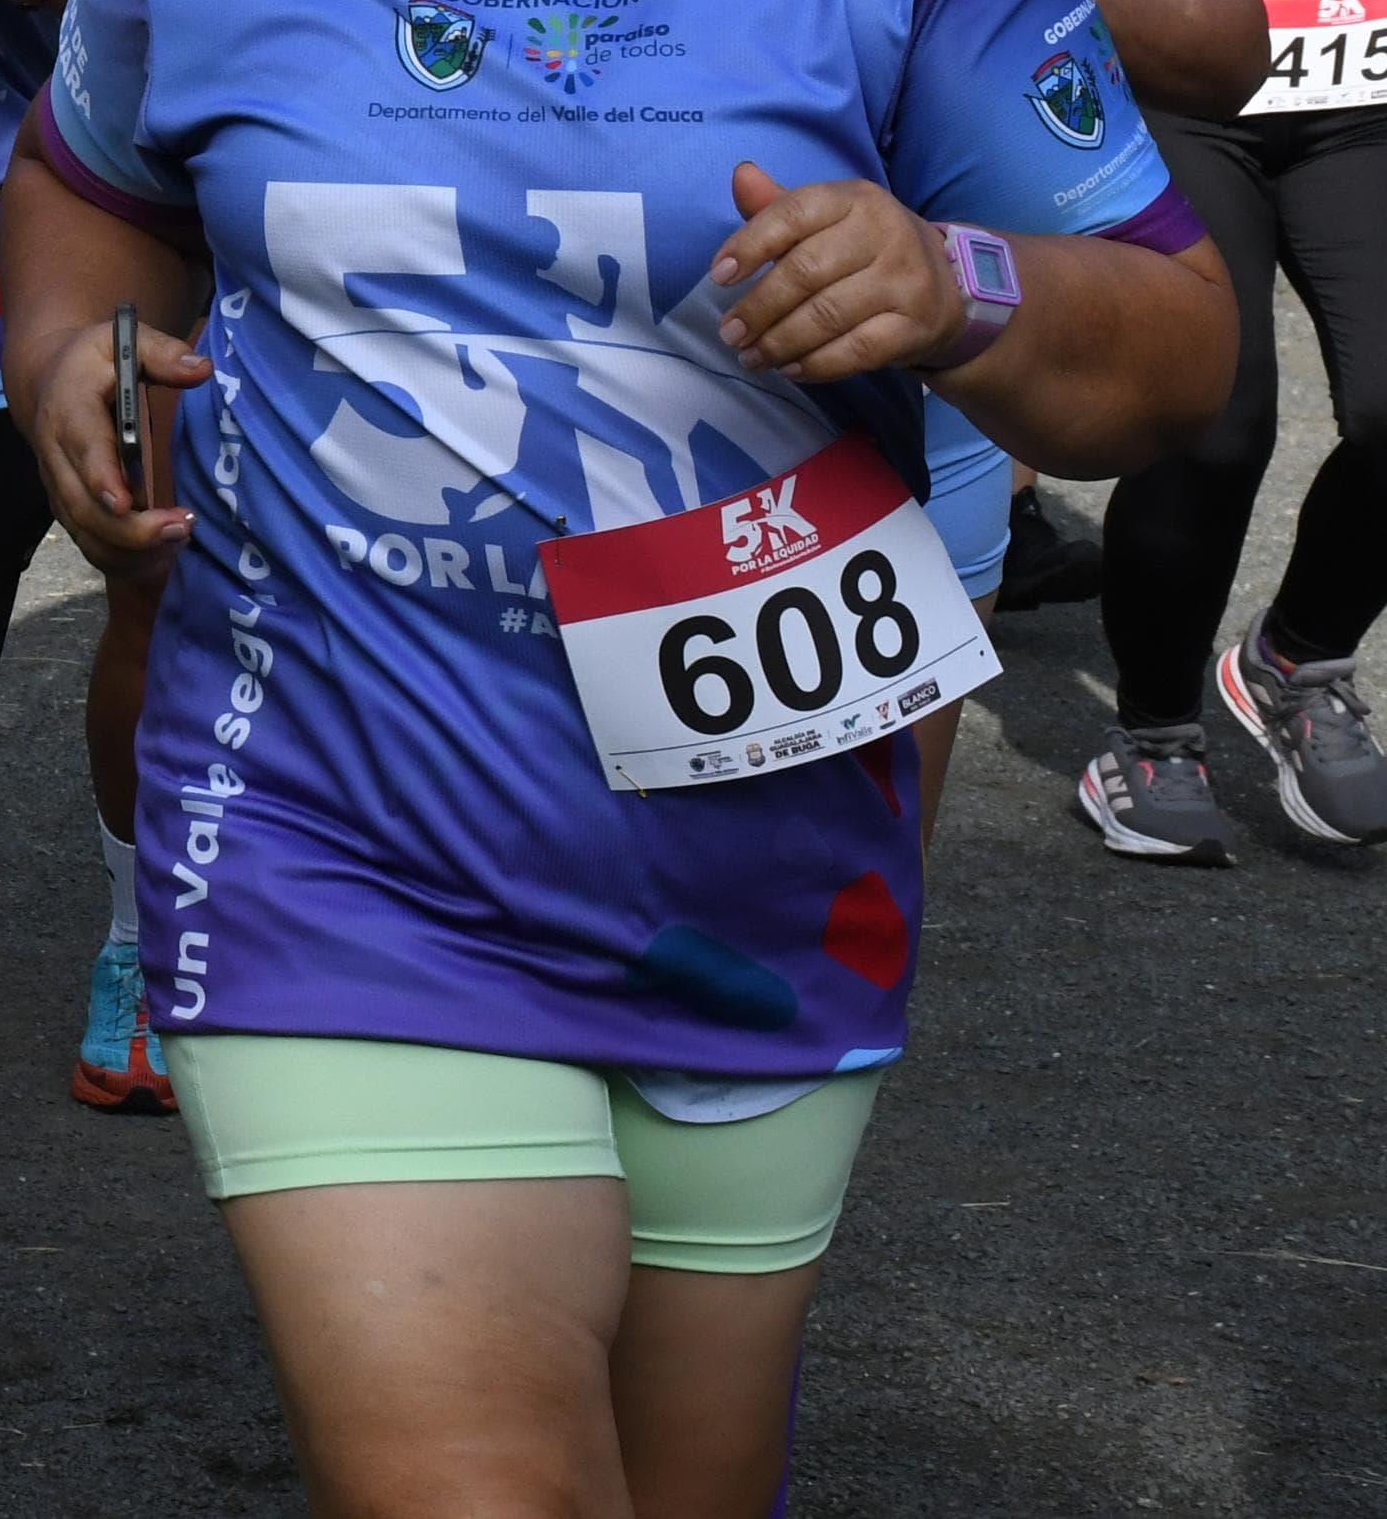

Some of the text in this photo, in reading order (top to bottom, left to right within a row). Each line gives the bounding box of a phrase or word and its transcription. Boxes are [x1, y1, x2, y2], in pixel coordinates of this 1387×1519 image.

[585, 23, 670, 49] paraíso
[585, 38, 687, 66] de todos
[368, 102, 705, 124] Departamento del Valle del Cauca
[263, 181, 847, 527] 5K
[721, 473, 817, 563] 5K
[325, 524, 477, 590] POR
[731, 559, 756, 576] POR
[757, 554, 773, 567] LA
[773, 534, 819, 561] EQUIDAD
[658, 549, 920, 736] 608
[901, 684, 937, 710] BLANCO
[775, 740, 821, 760] DE BUGA
[172, 765, 246, 909] Valle
[170, 930, 210, 1021] Un
